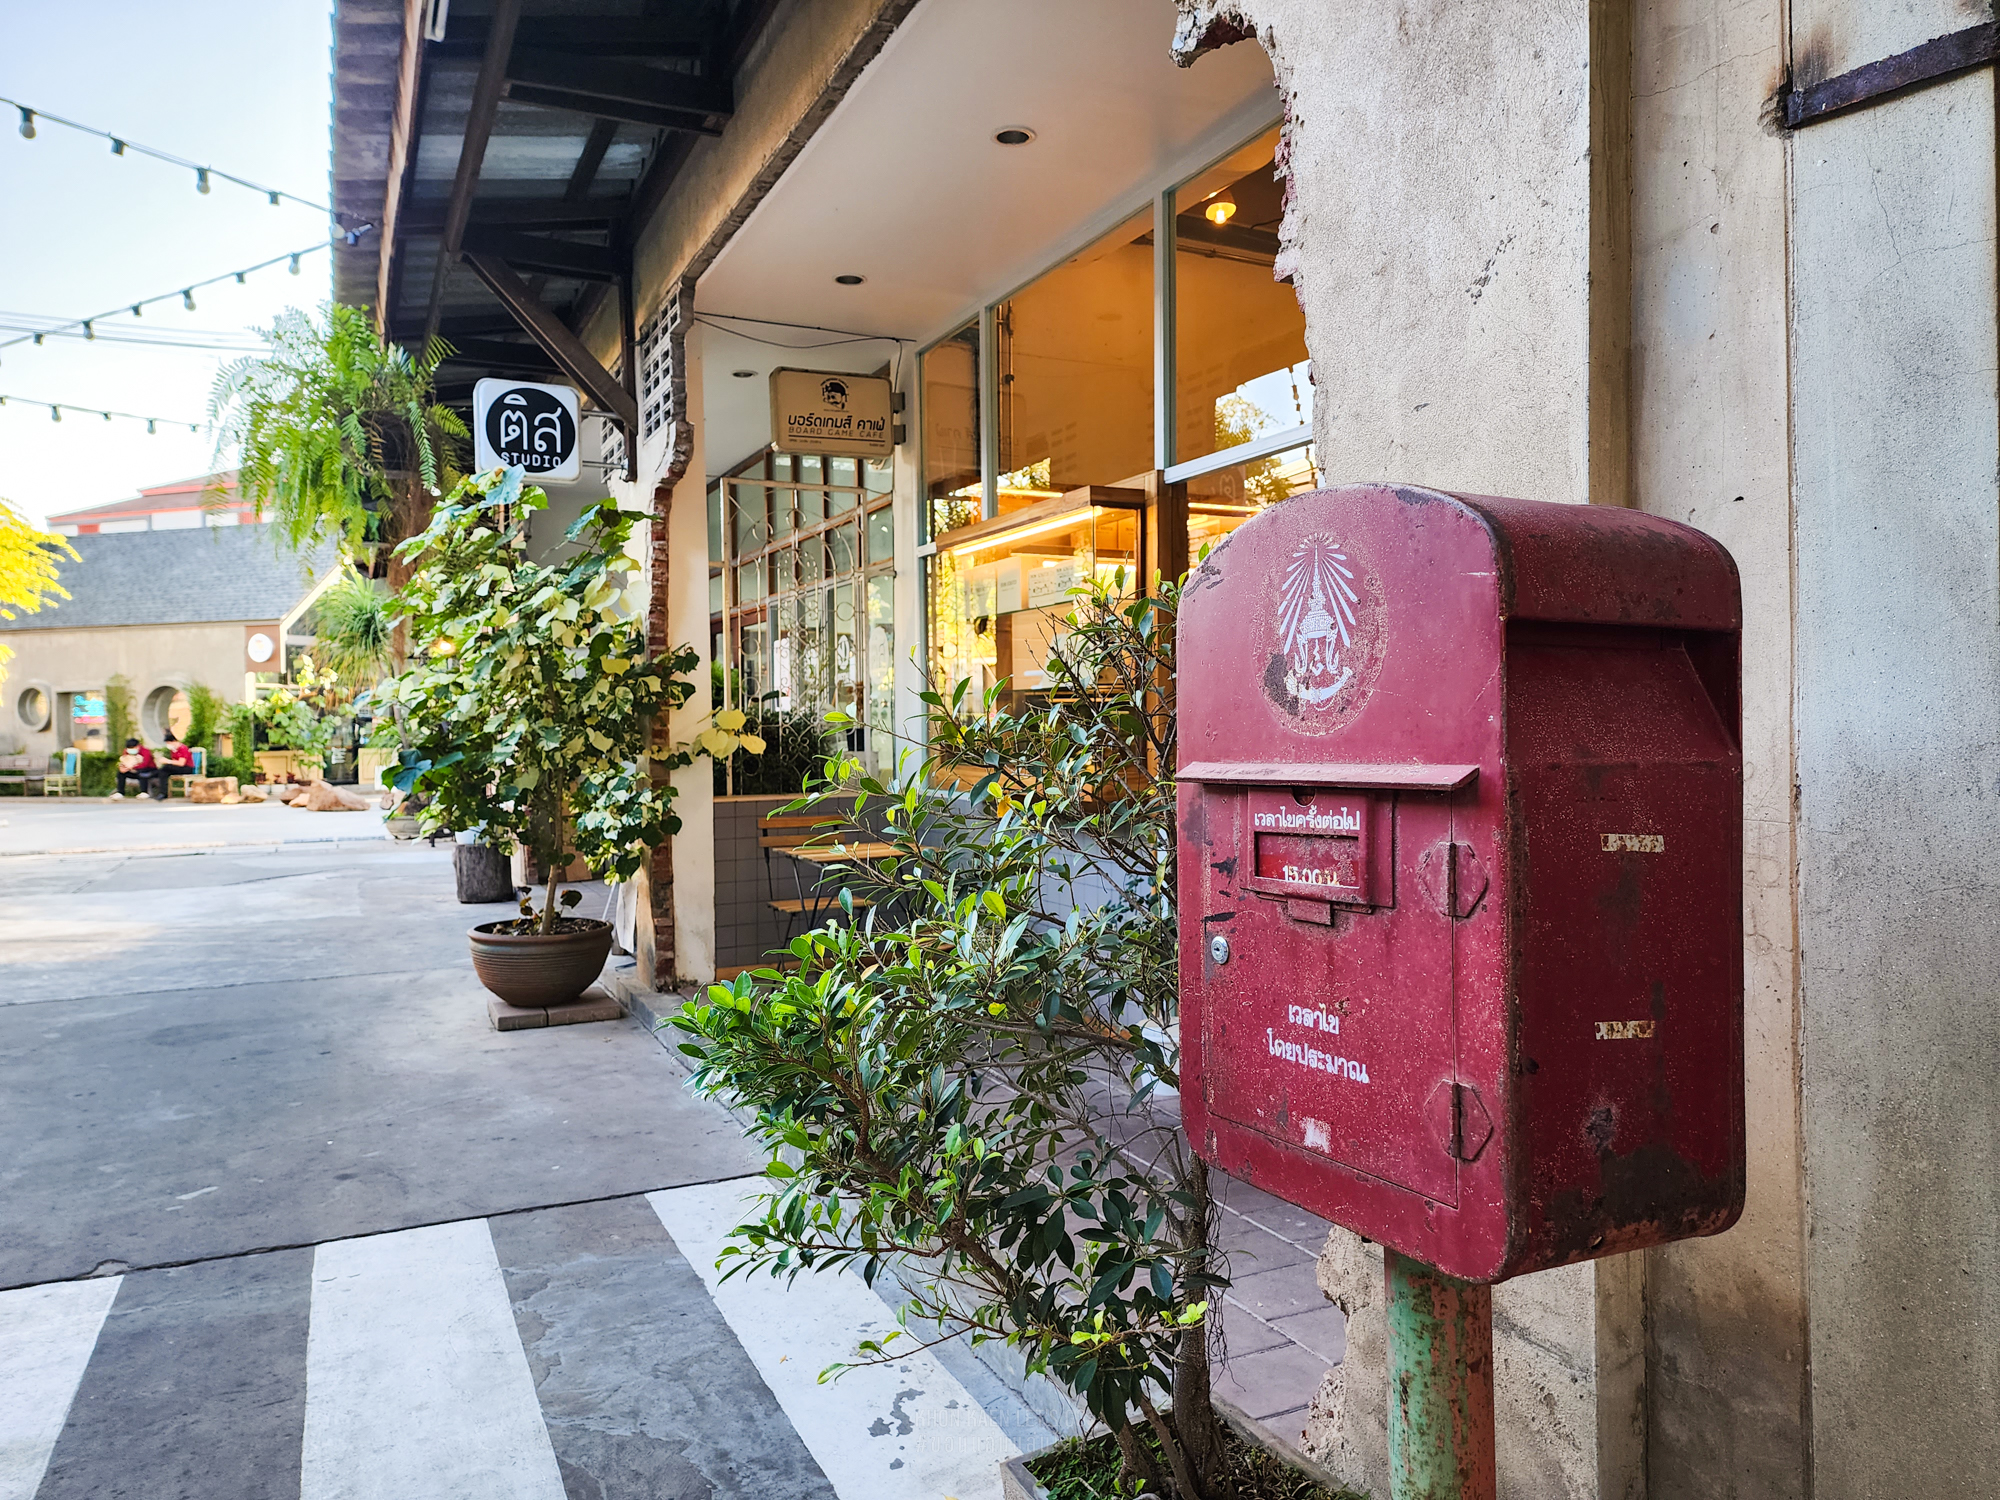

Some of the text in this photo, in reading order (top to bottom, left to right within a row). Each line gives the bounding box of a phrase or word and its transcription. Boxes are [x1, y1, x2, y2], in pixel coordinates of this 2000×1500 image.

[500, 393, 562, 453] ติส
[788, 413, 885, 431] บอร์ดเกมส์ คาเฟ่
[788, 426, 884, 439] BOARD GAME CAFE
[500, 452, 562, 467] STUDIO
[1254, 805, 1361, 830] เวลาไขครั้งต่อไป
[1288, 1003, 1340, 1034] เวลาไข
[1267, 1028, 1370, 1084] โดยประมาณ
